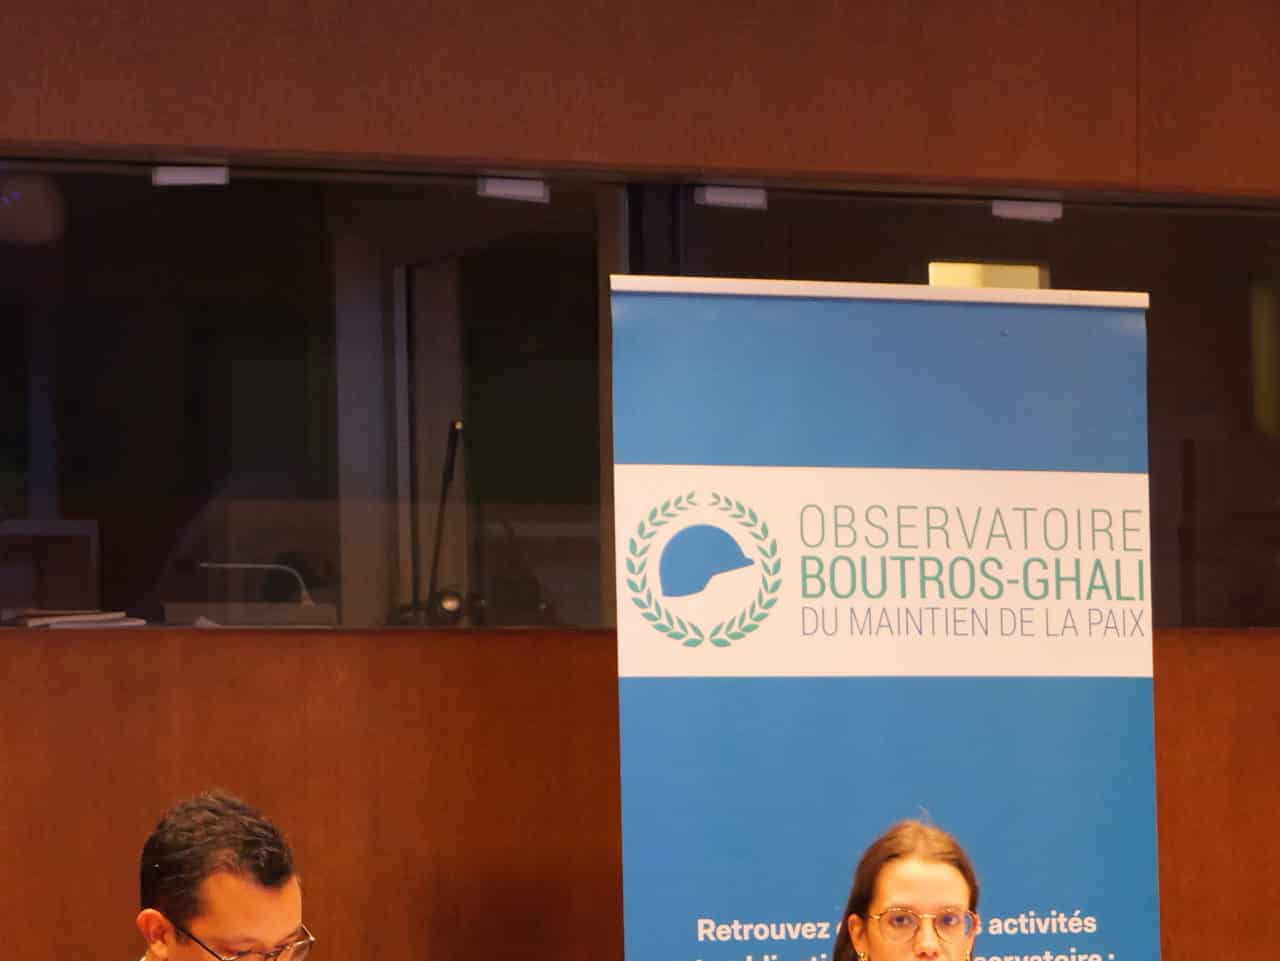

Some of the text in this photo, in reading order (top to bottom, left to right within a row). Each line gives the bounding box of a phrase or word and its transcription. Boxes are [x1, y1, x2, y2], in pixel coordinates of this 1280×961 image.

[799, 504, 1143, 552] OBSERVATOIRE
[800, 555, 1145, 601] BOUTROS-GHALI
[801, 606, 1145, 638] DU MAINTIEN DE LA PAIX
[697, 918, 831, 942] Retrouvez
[988, 909, 1097, 935] activités
